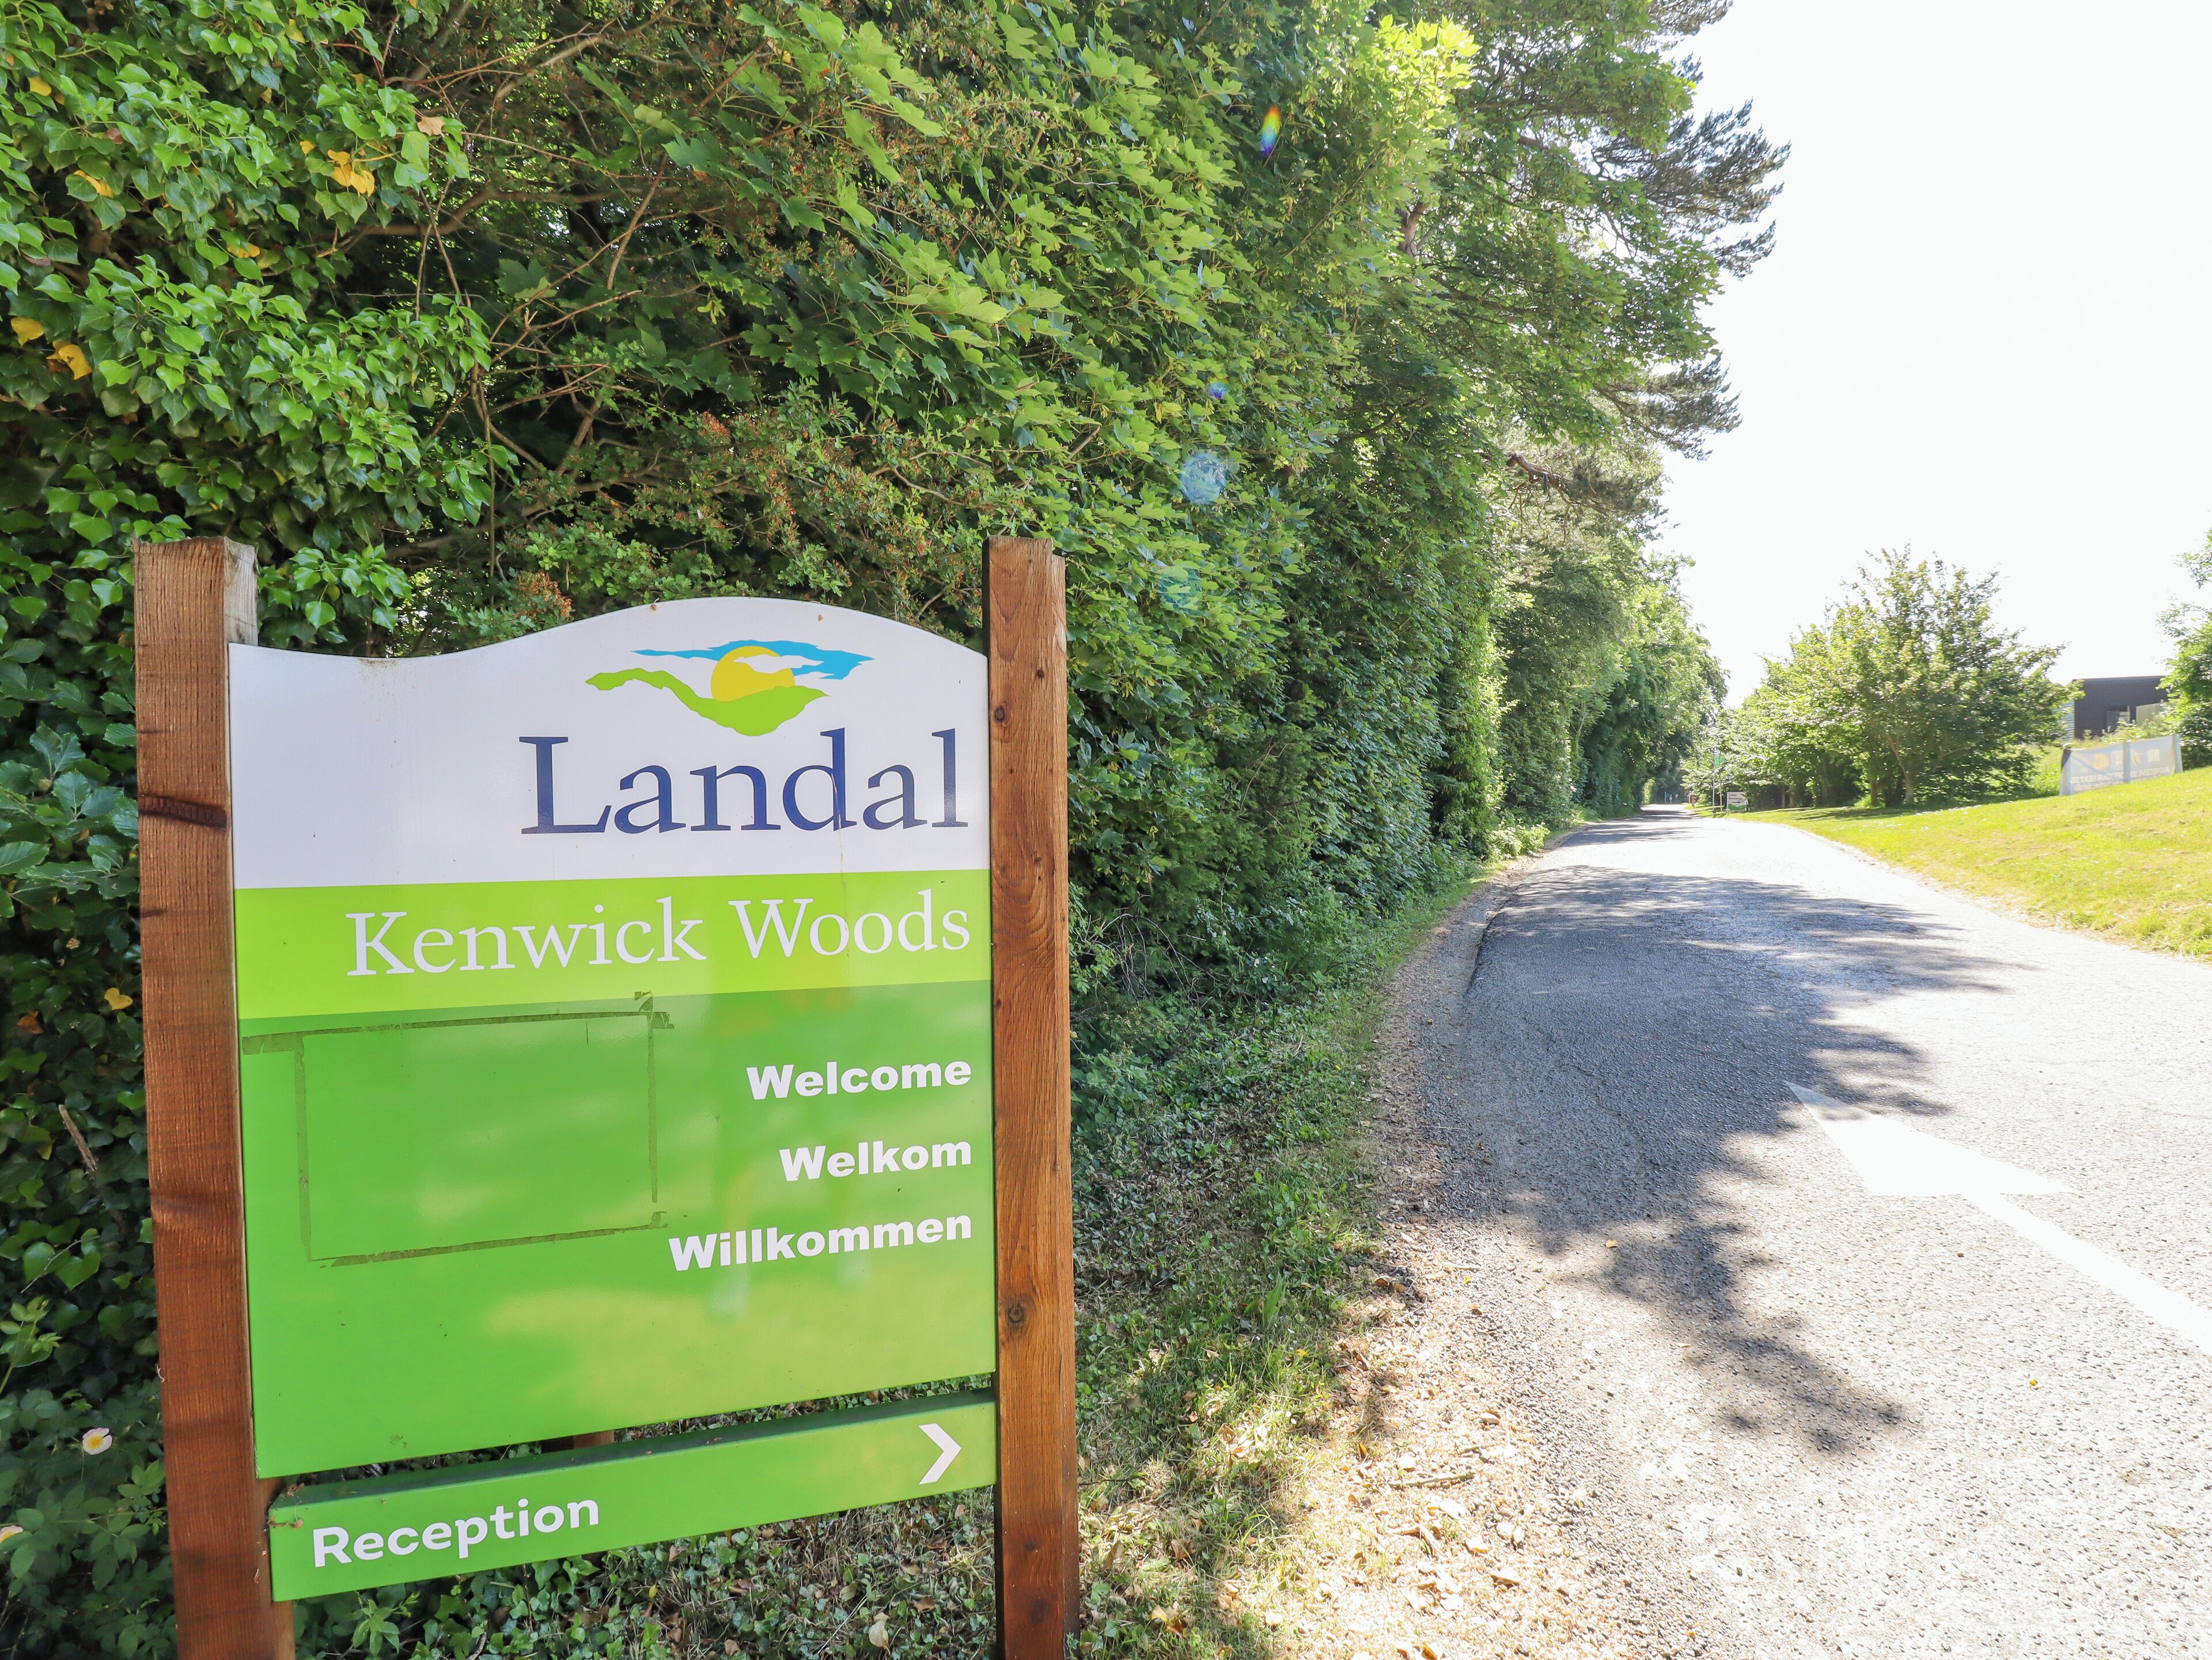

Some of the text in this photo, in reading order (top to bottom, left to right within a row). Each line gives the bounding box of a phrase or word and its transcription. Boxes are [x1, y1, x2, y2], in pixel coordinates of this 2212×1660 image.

[519, 727, 968, 834] Landal
[346, 889, 969, 975] Kenwick Woods
[747, 1062, 971, 1100] Welcome
[779, 1141, 971, 1181] Welkom
[669, 1215, 971, 1271] Willkommen
[313, 1499, 599, 1567] Reception
